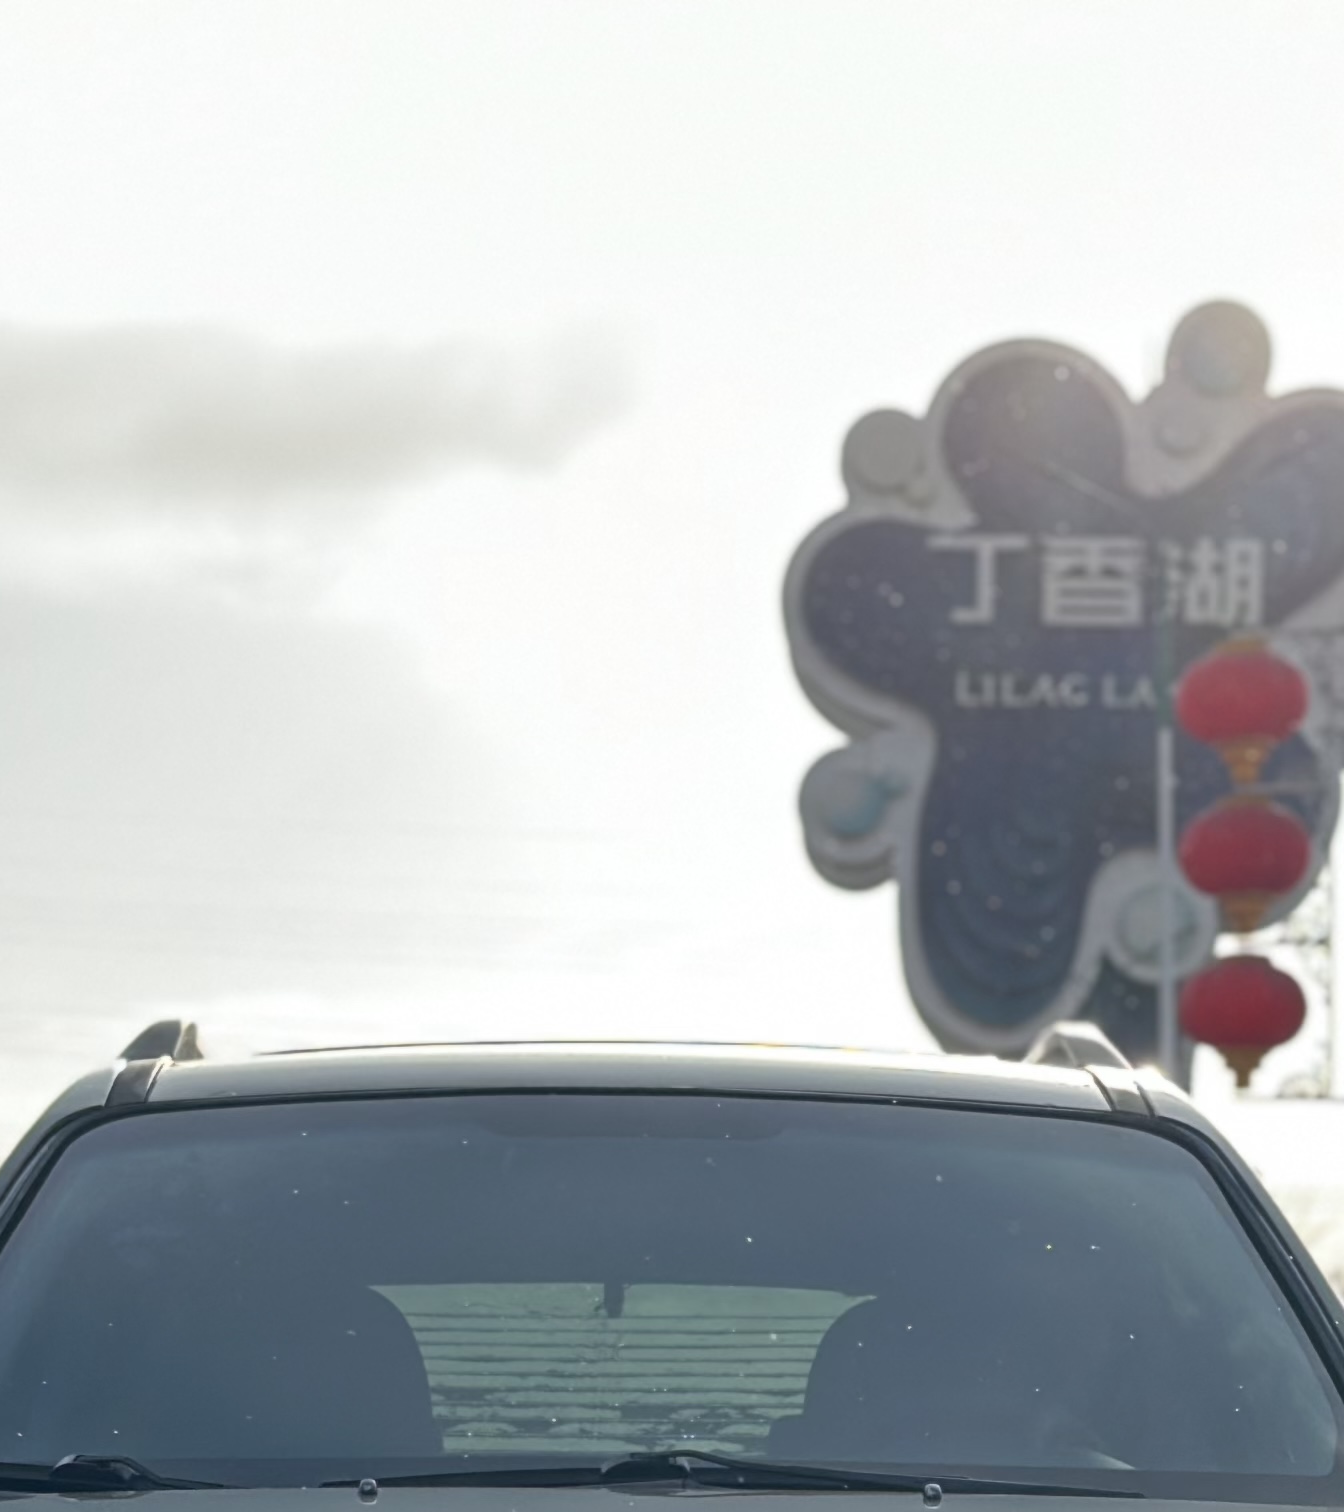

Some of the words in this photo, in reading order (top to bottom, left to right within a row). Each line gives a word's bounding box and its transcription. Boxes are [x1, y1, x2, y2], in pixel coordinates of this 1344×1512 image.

[926, 533, 1263, 626] 丁香湖
[957, 670, 1089, 708] LILAC
[1101, 672, 1178, 708] LA
